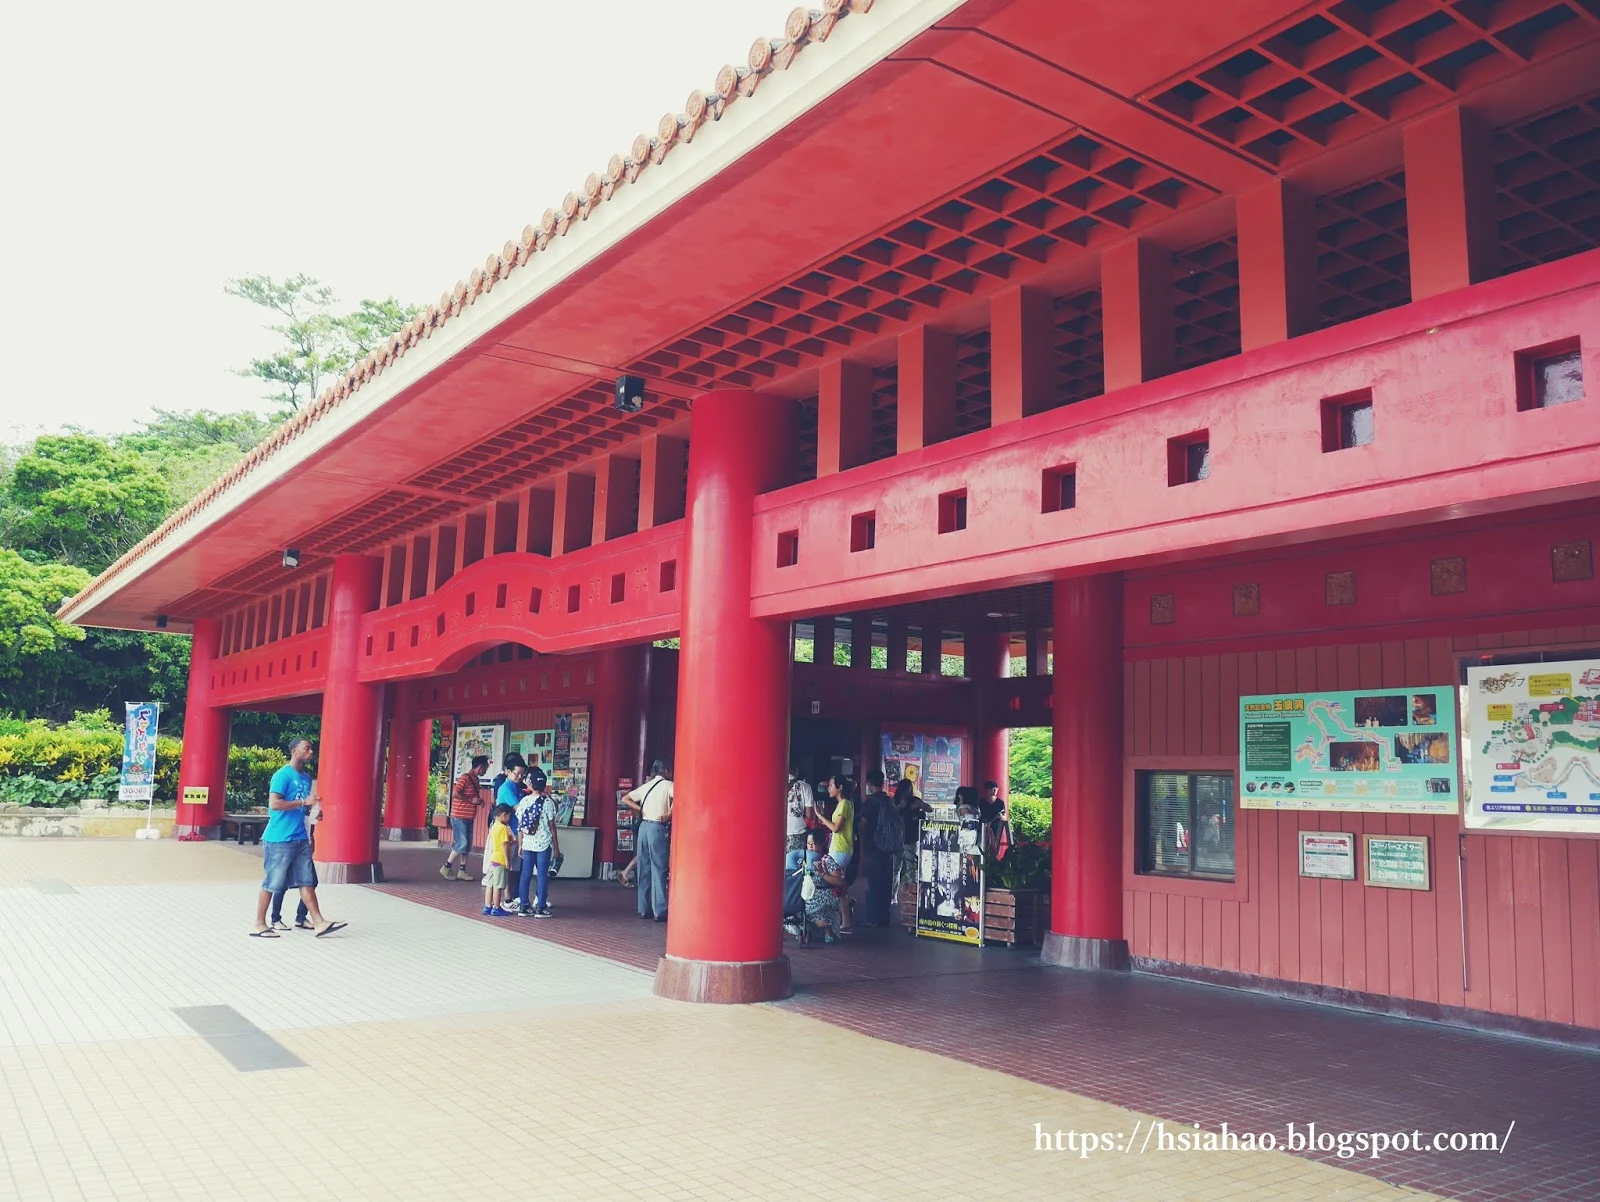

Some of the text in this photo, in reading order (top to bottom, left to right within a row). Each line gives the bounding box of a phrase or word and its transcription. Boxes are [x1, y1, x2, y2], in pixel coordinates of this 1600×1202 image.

[921, 820, 957, 832] Adventure
[1372, 842, 1422, 851] スーパーエイサー
